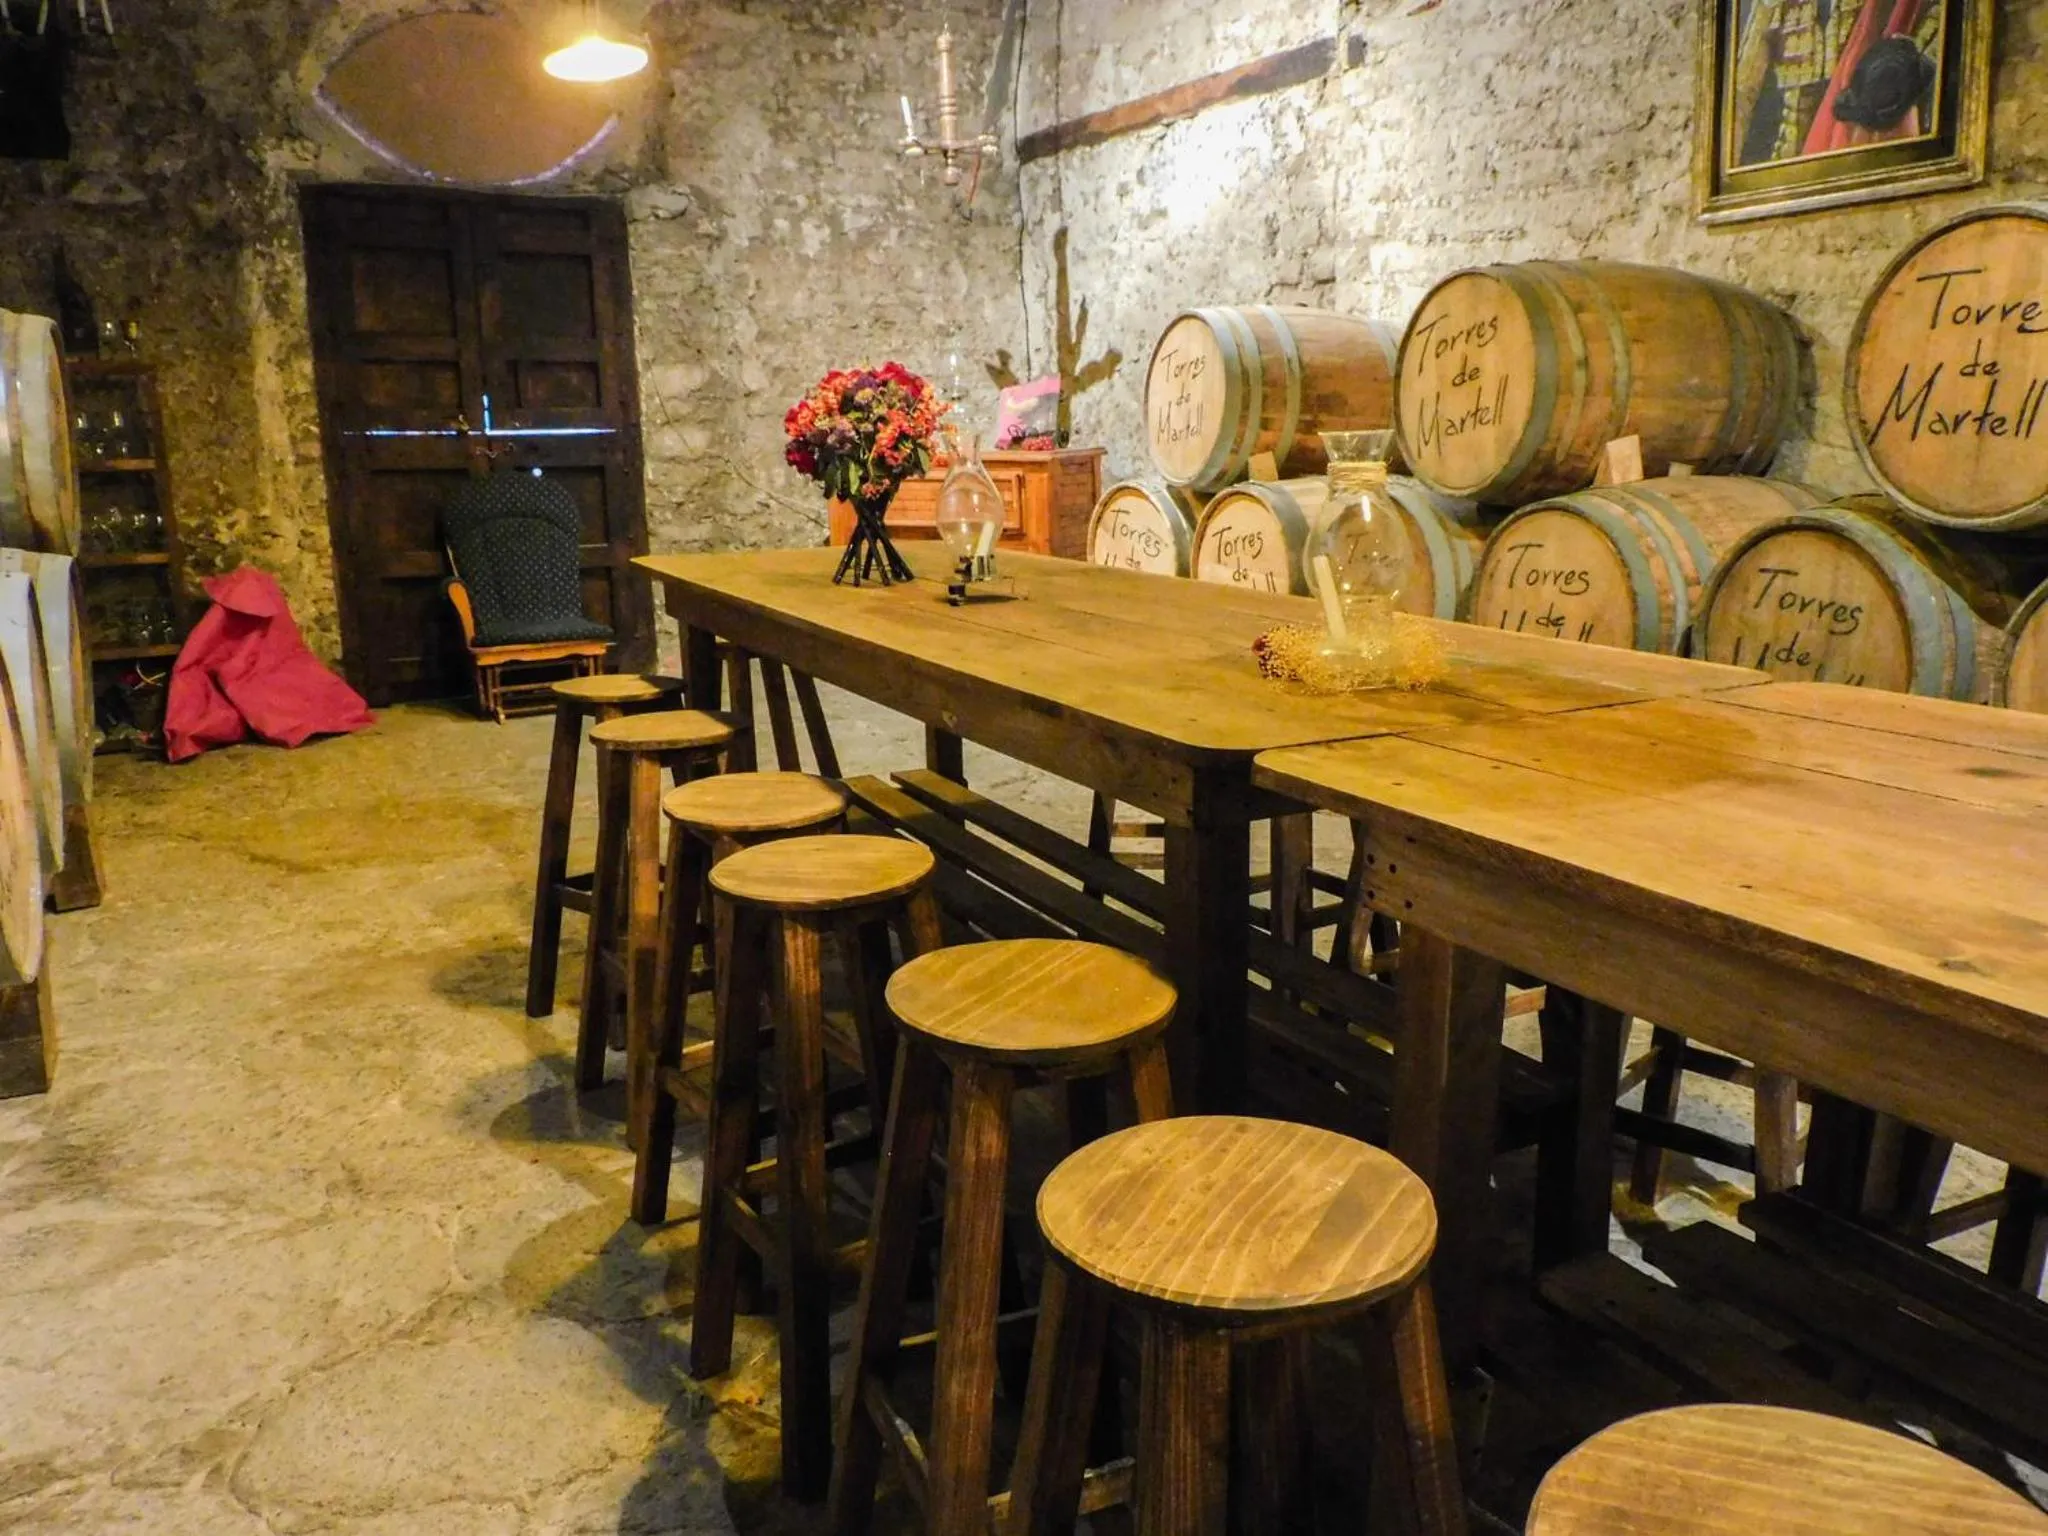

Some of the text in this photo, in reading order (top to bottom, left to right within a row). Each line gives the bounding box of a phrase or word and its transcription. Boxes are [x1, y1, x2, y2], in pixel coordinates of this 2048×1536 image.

[1916, 267, 2048, 334] Torre
[1416, 313, 1499, 377] Torres
[1957, 338, 2001, 377] de
[1160, 349, 1206, 384] Torres
[1452, 352, 1481, 387] de
[1175, 382, 1192, 407] de
[1867, 361, 2048, 447] Martell
[1156, 400, 1204, 445] Martell
[1417, 374, 1510, 459] Martell
[1211, 526, 1265, 565] Torres
[1232, 557, 1250, 582] de
[1507, 543, 1590, 596] Torres
[1535, 601, 1566, 628] de
[1753, 567, 1864, 635] Torres
[1775, 631, 1812, 666] de
